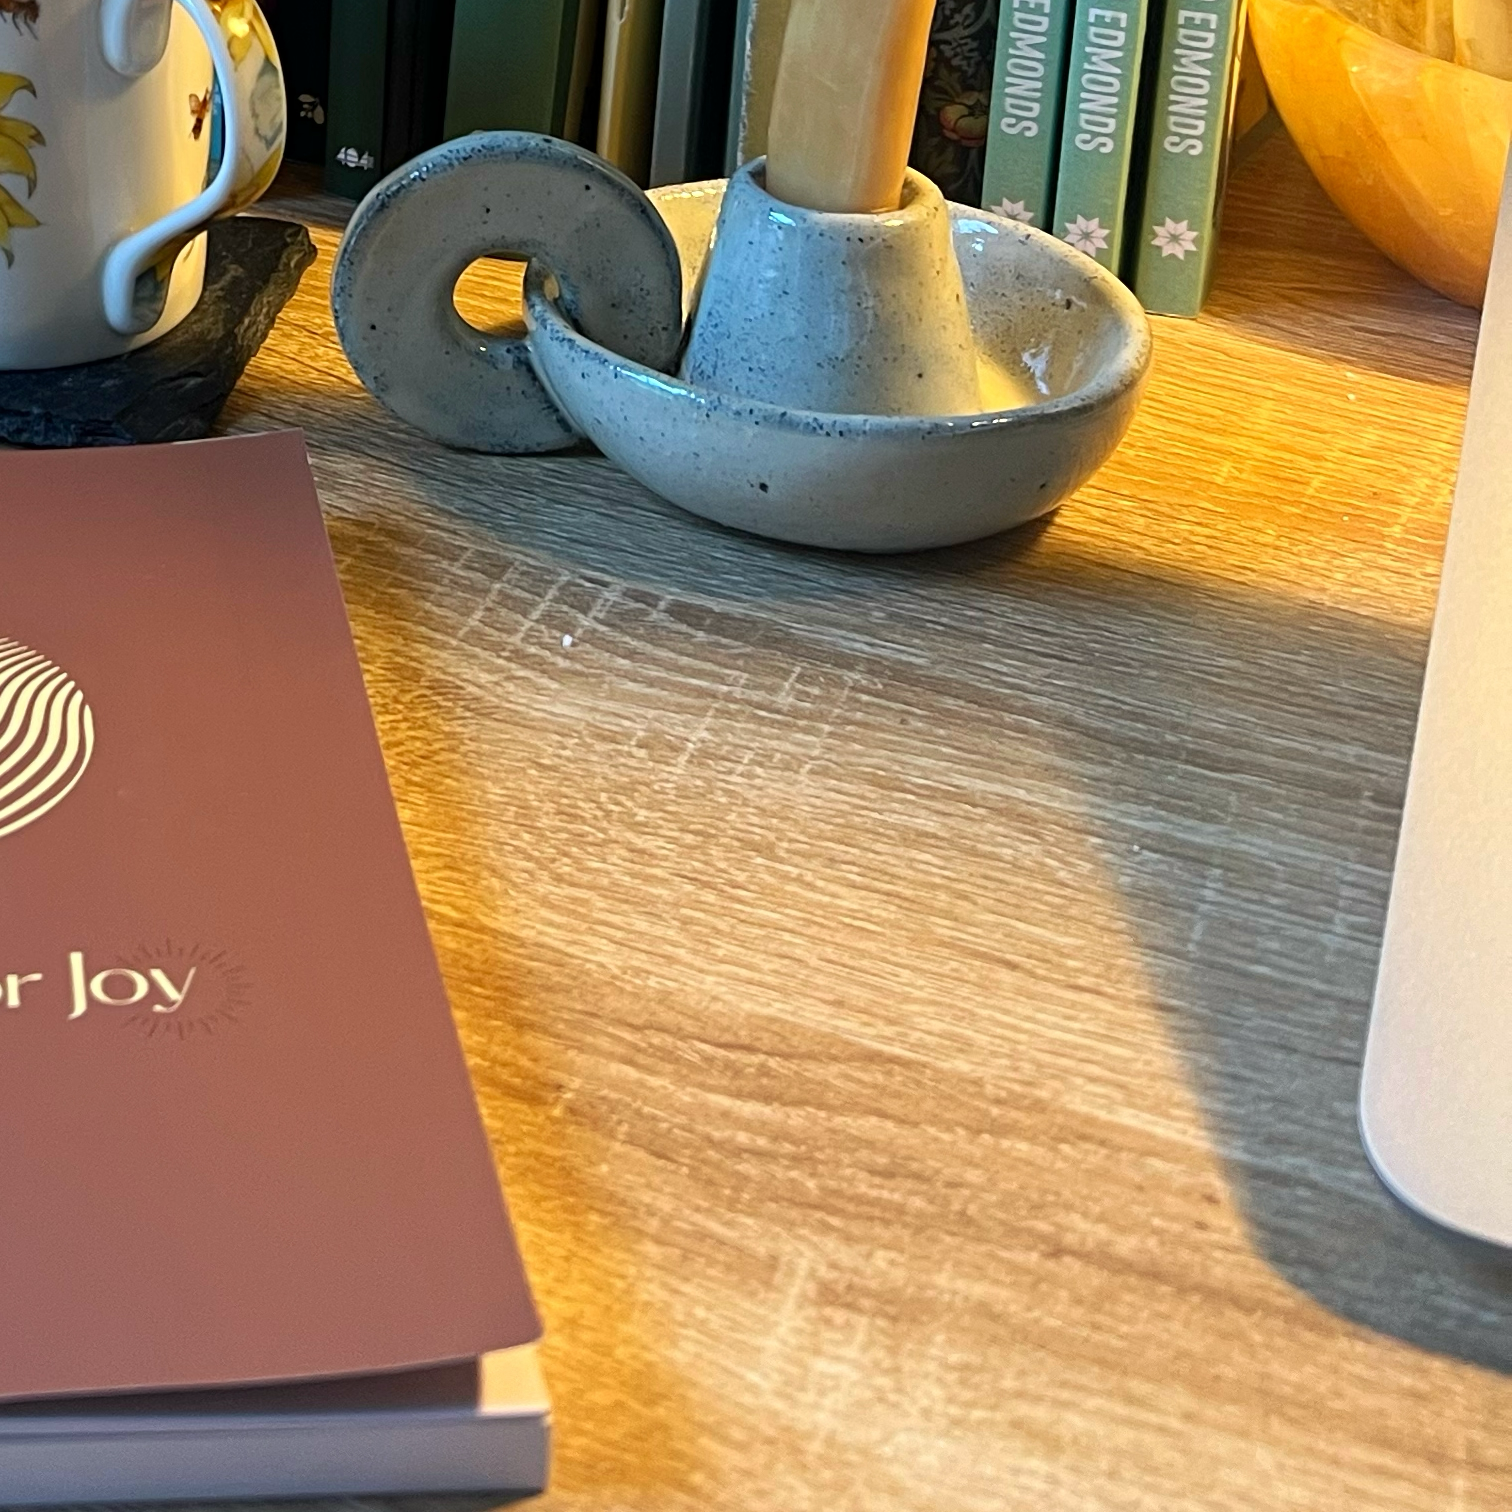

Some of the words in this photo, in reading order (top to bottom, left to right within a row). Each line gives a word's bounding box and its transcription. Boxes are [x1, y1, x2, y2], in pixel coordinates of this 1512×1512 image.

[1075, 7, 1128, 154] EDMONDS
[1163, 9, 1217, 155] EDMONDS
[66, 950, 198, 1020] Joy
